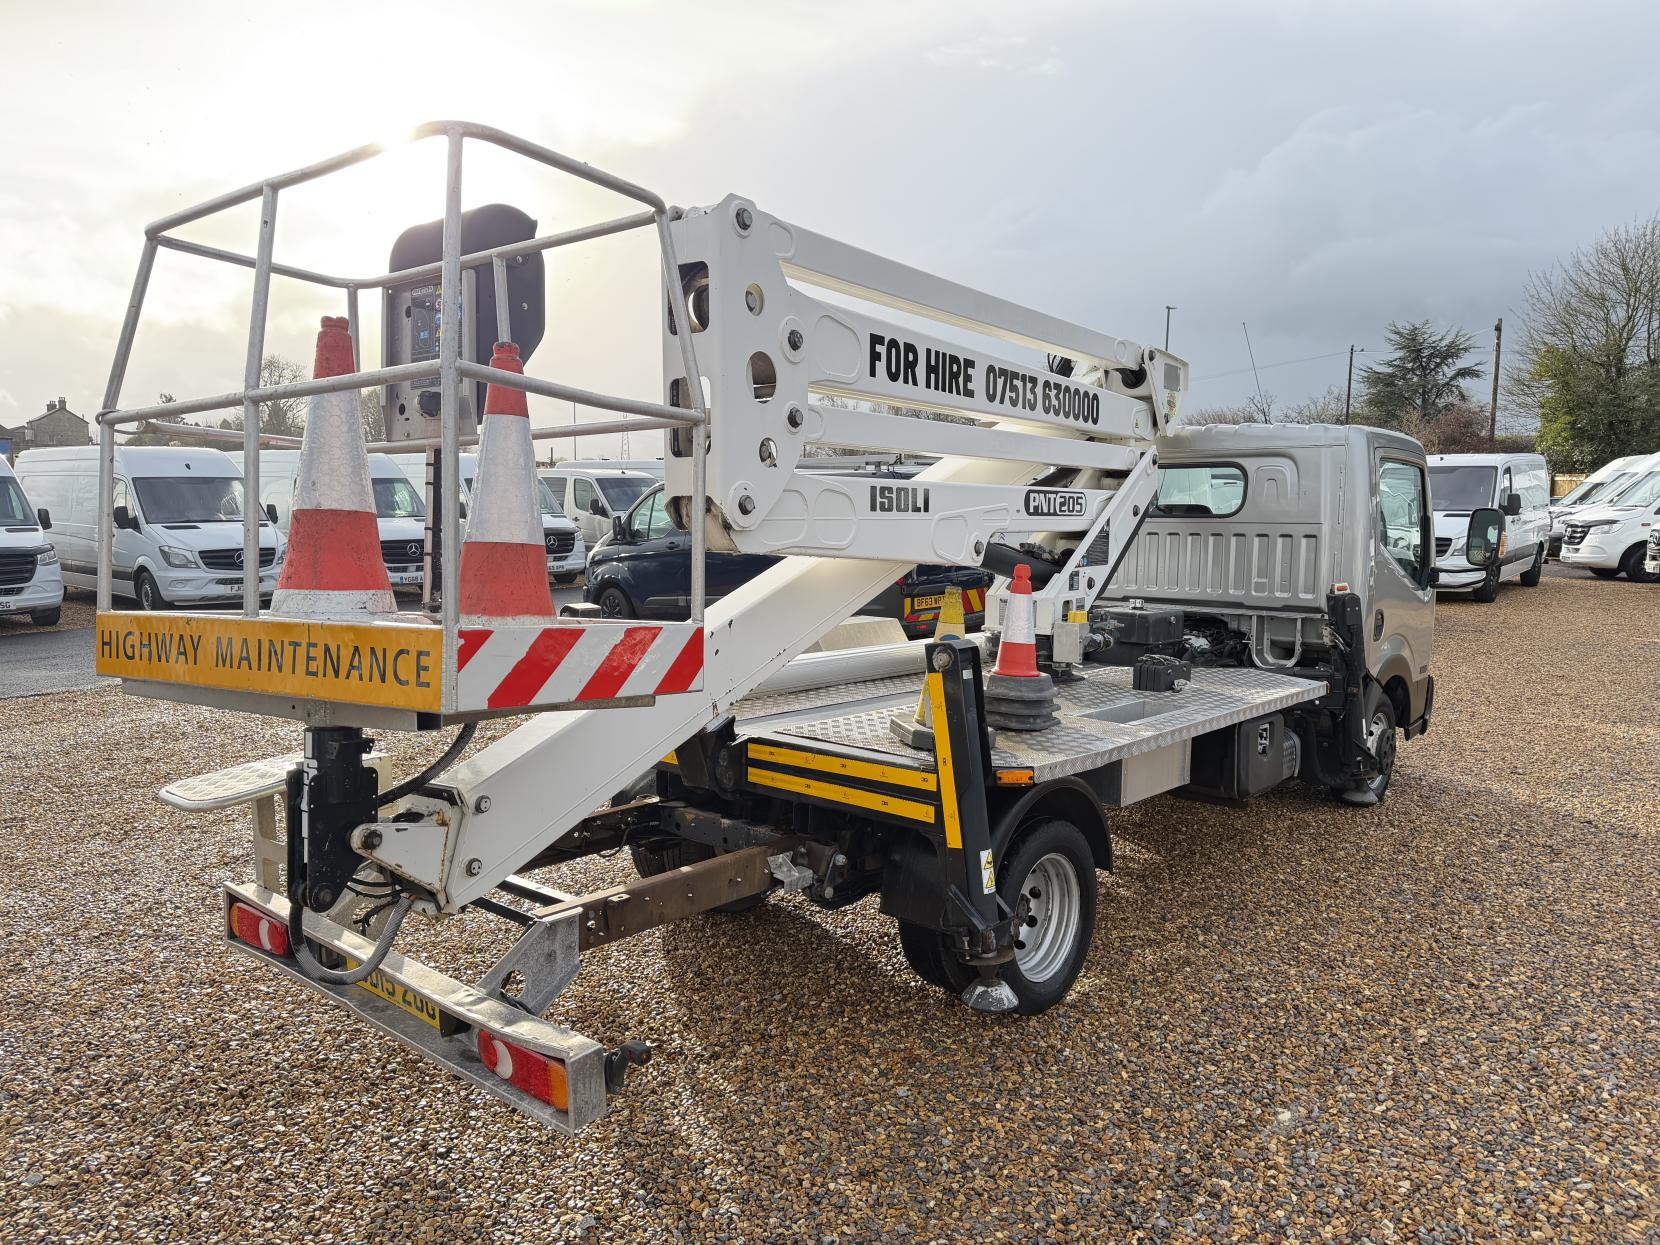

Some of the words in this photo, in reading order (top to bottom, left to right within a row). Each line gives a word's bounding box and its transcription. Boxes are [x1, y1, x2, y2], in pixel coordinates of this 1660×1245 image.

[869, 332, 919, 387] FOR
[925, 347, 976, 399] HIRE
[985, 364, 1038, 412] 07513
[1042, 379, 1100, 426] 630000
[869, 485, 930, 513] ISOLI
[101, 629, 202, 666] HIGHWAY
[215, 635, 431, 689] MAINTENANCE
